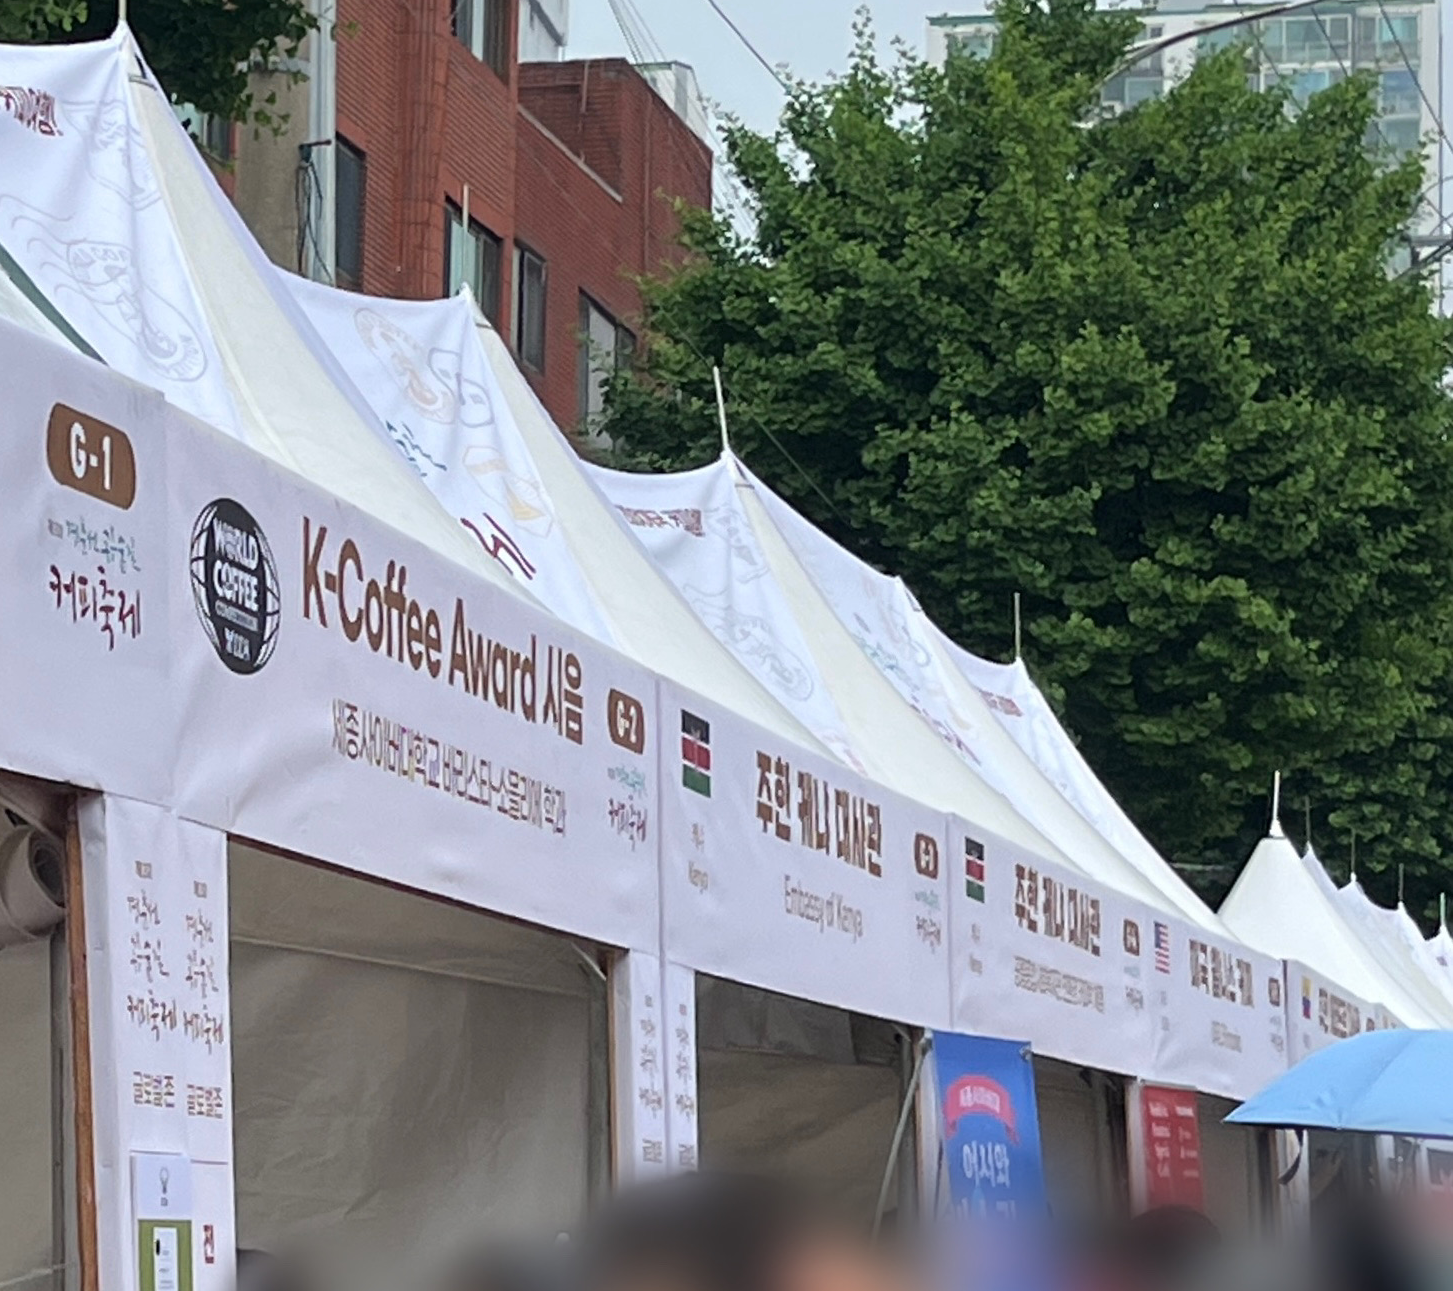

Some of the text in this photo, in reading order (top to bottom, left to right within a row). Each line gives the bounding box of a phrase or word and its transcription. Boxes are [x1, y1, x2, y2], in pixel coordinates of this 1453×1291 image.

[70, 421, 112, 491] G-1
[303, 515, 441, 679] K-Coffee
[448, 597, 537, 724] Award
[542, 644, 584, 746] 시음
[616, 699, 638, 745] G-2
[755, 749, 792, 843] 주한
